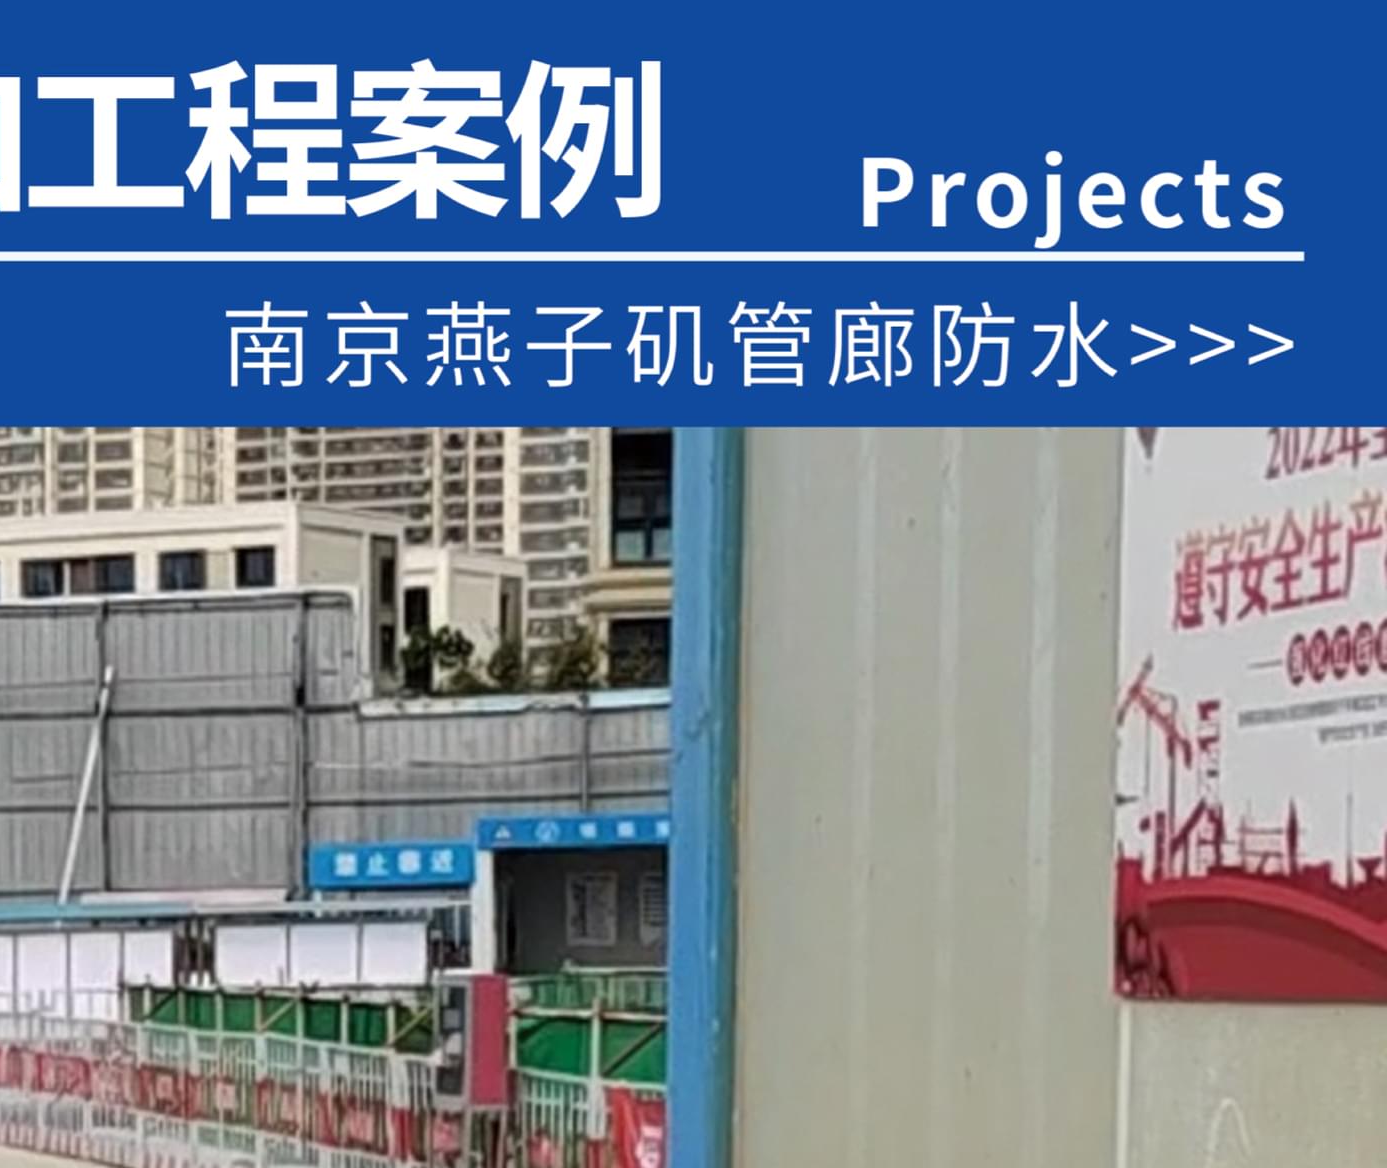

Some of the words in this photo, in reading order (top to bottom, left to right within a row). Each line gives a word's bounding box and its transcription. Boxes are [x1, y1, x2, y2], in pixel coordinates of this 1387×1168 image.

[1173, 488, 1387, 631] 遵守安全生产
